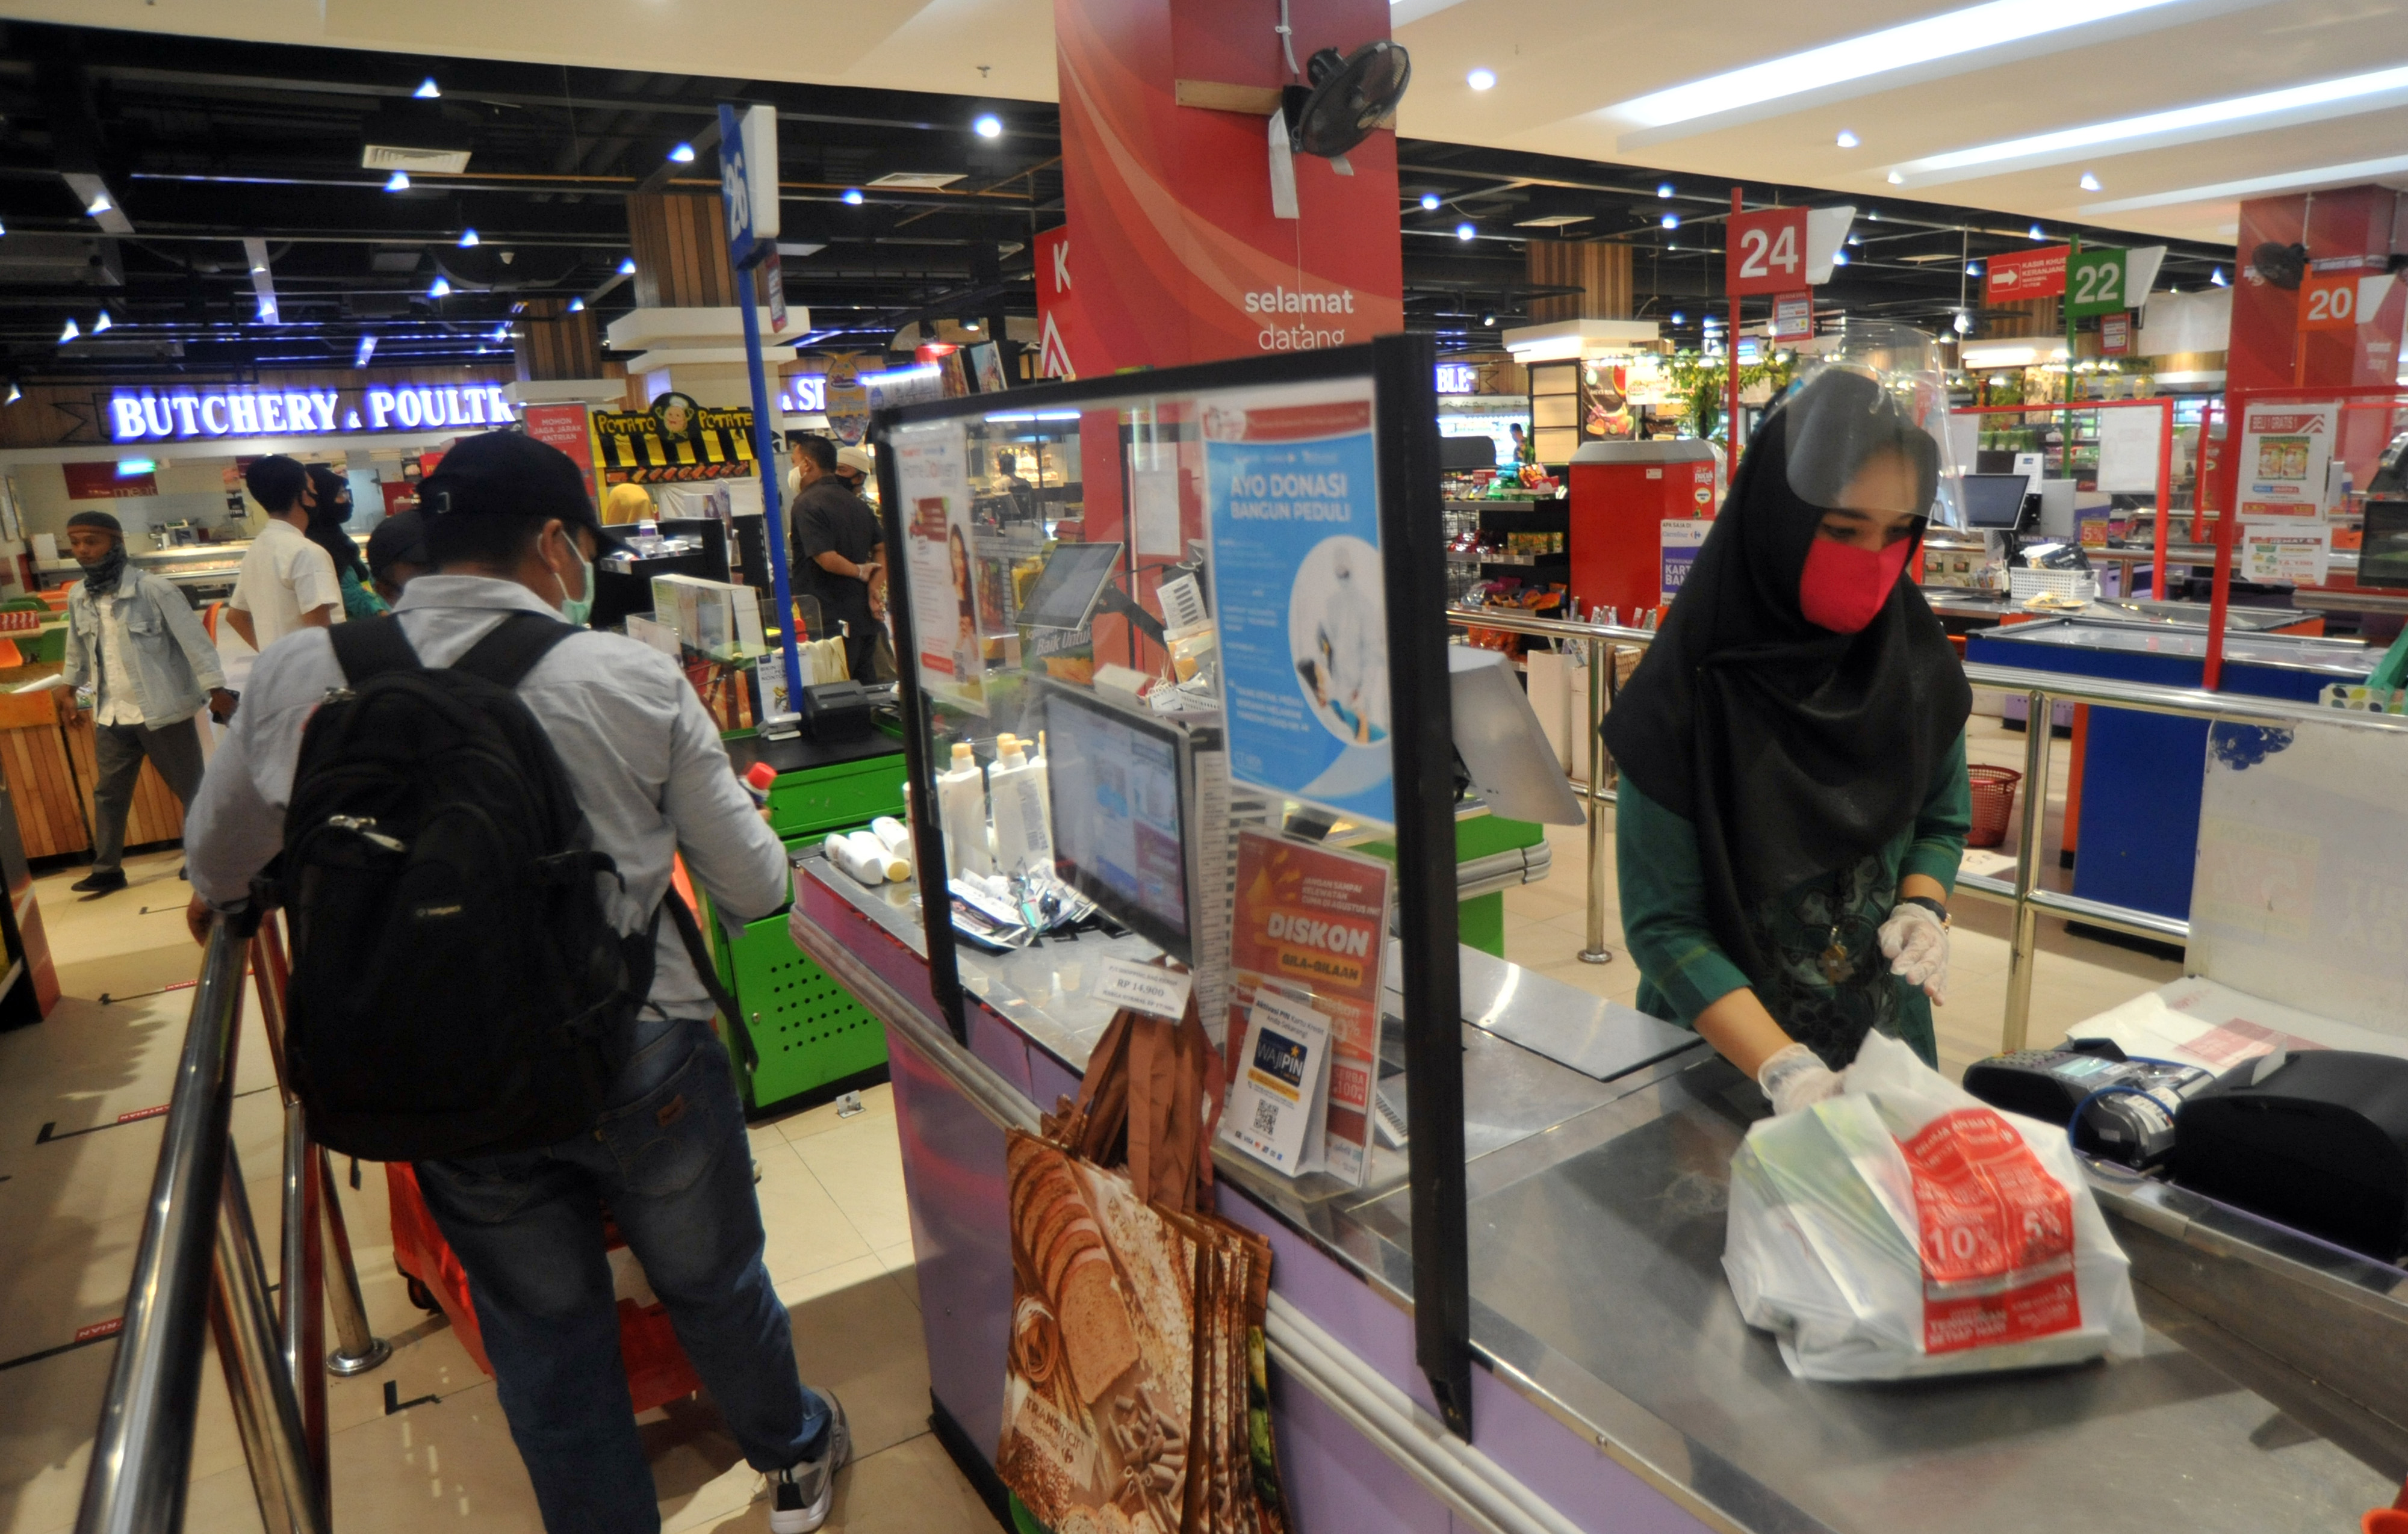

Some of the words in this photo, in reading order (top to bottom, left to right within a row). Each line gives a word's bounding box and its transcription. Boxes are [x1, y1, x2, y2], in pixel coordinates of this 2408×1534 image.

[1739, 226, 1799, 279] 24
[2074, 262, 2120, 304] 22
[1244, 285, 1354, 314] selamat
[2307, 286, 2353, 321] 20
[1258, 323, 1345, 350] datang
[113, 394, 338, 439] BUTCHERY
[348, 411, 362, 429] &
[369, 388, 516, 427] POULTR
[597, 414, 657, 434] POTATO
[1230, 474, 1267, 498] AYO
[1270, 472, 1348, 498] DONASI
[1230, 501, 1291, 520] BANGUN
[1294, 502, 1351, 522] PEDULI
[2084, 526, 2103, 540] 5%
[1665, 564, 1691, 575] KART
[1036, 635, 1061, 656] Baik
[1331, 901, 1366, 913] AGUSTUS
[1268, 912, 1370, 957] DISKON
[1117, 979, 1131, 988] RP
[1256, 1000, 1280, 1015] Aktivasi
[1279, 1010, 1291, 1020] PIN
[1291, 1015, 1307, 1027] Kartu
[1307, 1022, 1324, 1035] Kredit
